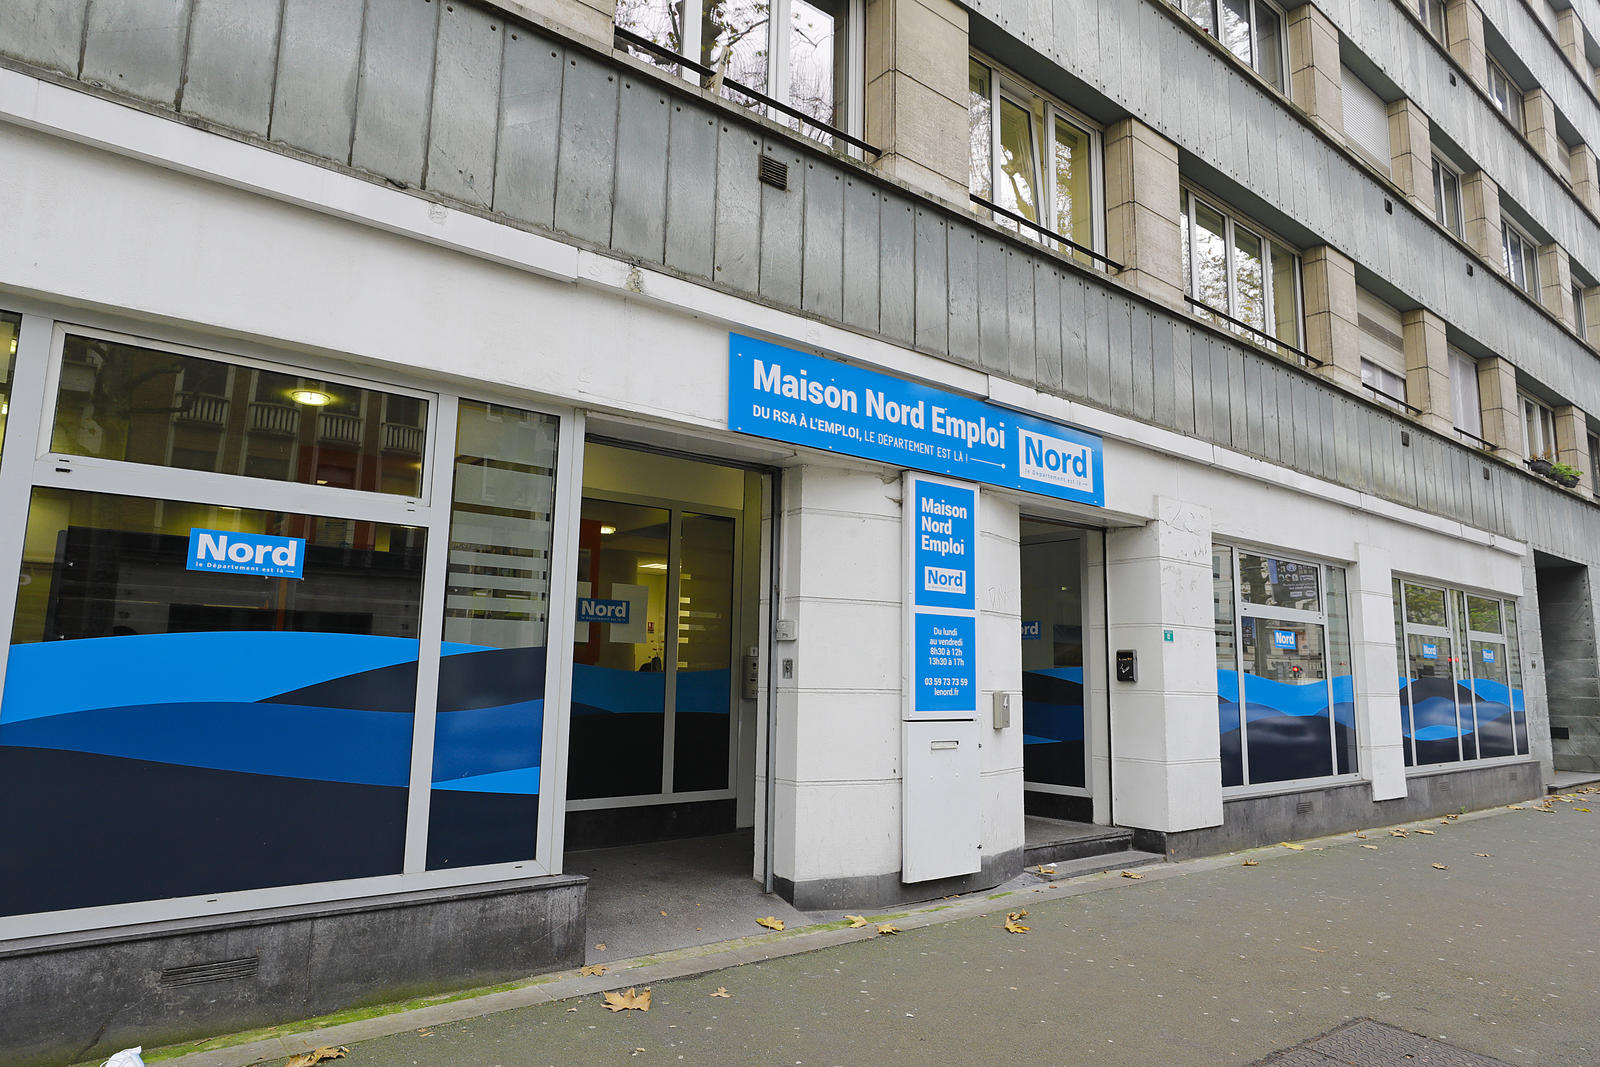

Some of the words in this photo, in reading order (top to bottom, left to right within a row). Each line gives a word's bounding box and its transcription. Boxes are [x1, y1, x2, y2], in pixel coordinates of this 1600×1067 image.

[753, 358, 858, 414] Maison
[865, 388, 925, 430] Nord
[931, 405, 1005, 449] Emploi
[752, 404, 771, 419] DU
[772, 408, 798, 426] RSA
[799, 412, 808, 428] À
[809, 417, 863, 442] L'EMPLOI,
[864, 430, 876, 443] LE
[877, 432, 934, 456] DÉPARTEMENT
[937, 446, 951, 459] EST
[1024, 435, 1088, 479] Nord
[921, 496, 967, 519] Maison
[921, 515, 952, 535] Nord
[197, 533, 297, 567] Nord
[921, 534, 965, 557] Emploi
[206, 562, 259, 571] Département
[928, 569, 963, 587] Nord
[581, 600, 627, 617] Nord
[933, 626, 942, 636] Du
[943, 627, 958, 637] lundi
[1275, 631, 1295, 645] Nord
[938, 638, 964, 647] vendredi
[930, 647, 946, 656] 8h30
[946, 647, 951, 656] à
[952, 648, 963, 657] 12h
[928, 657, 947, 666] 13h30
[948, 657, 953, 666] à
[953, 658, 965, 667] 17h
[924, 677, 933, 686] 03
[933, 677, 942, 686] 59
[942, 677, 951, 686] 73
[951, 677, 960, 686] 73
[960, 678, 969, 687] 59
[934, 687, 960, 697] lenord.fr
